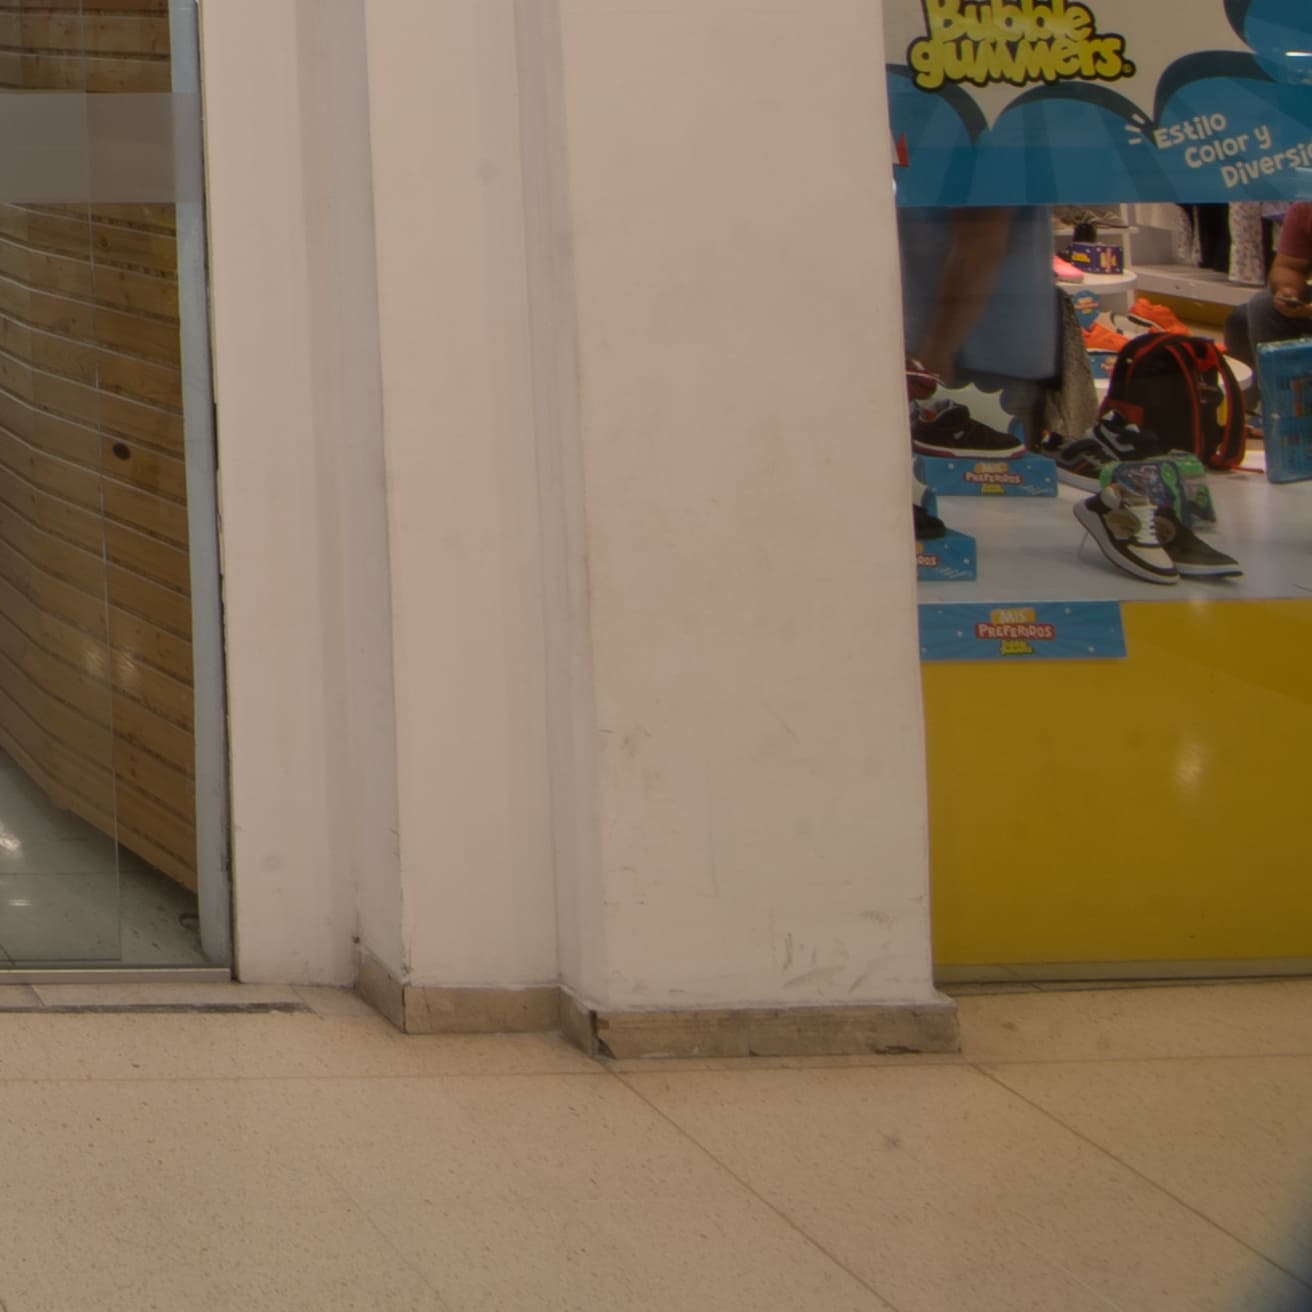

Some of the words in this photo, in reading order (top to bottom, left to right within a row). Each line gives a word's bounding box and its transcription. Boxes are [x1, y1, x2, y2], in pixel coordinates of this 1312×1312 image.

[1152, 112, 1227, 149] Estilo
[1184, 134, 1250, 169] Color
[1254, 125, 1273, 150] y
